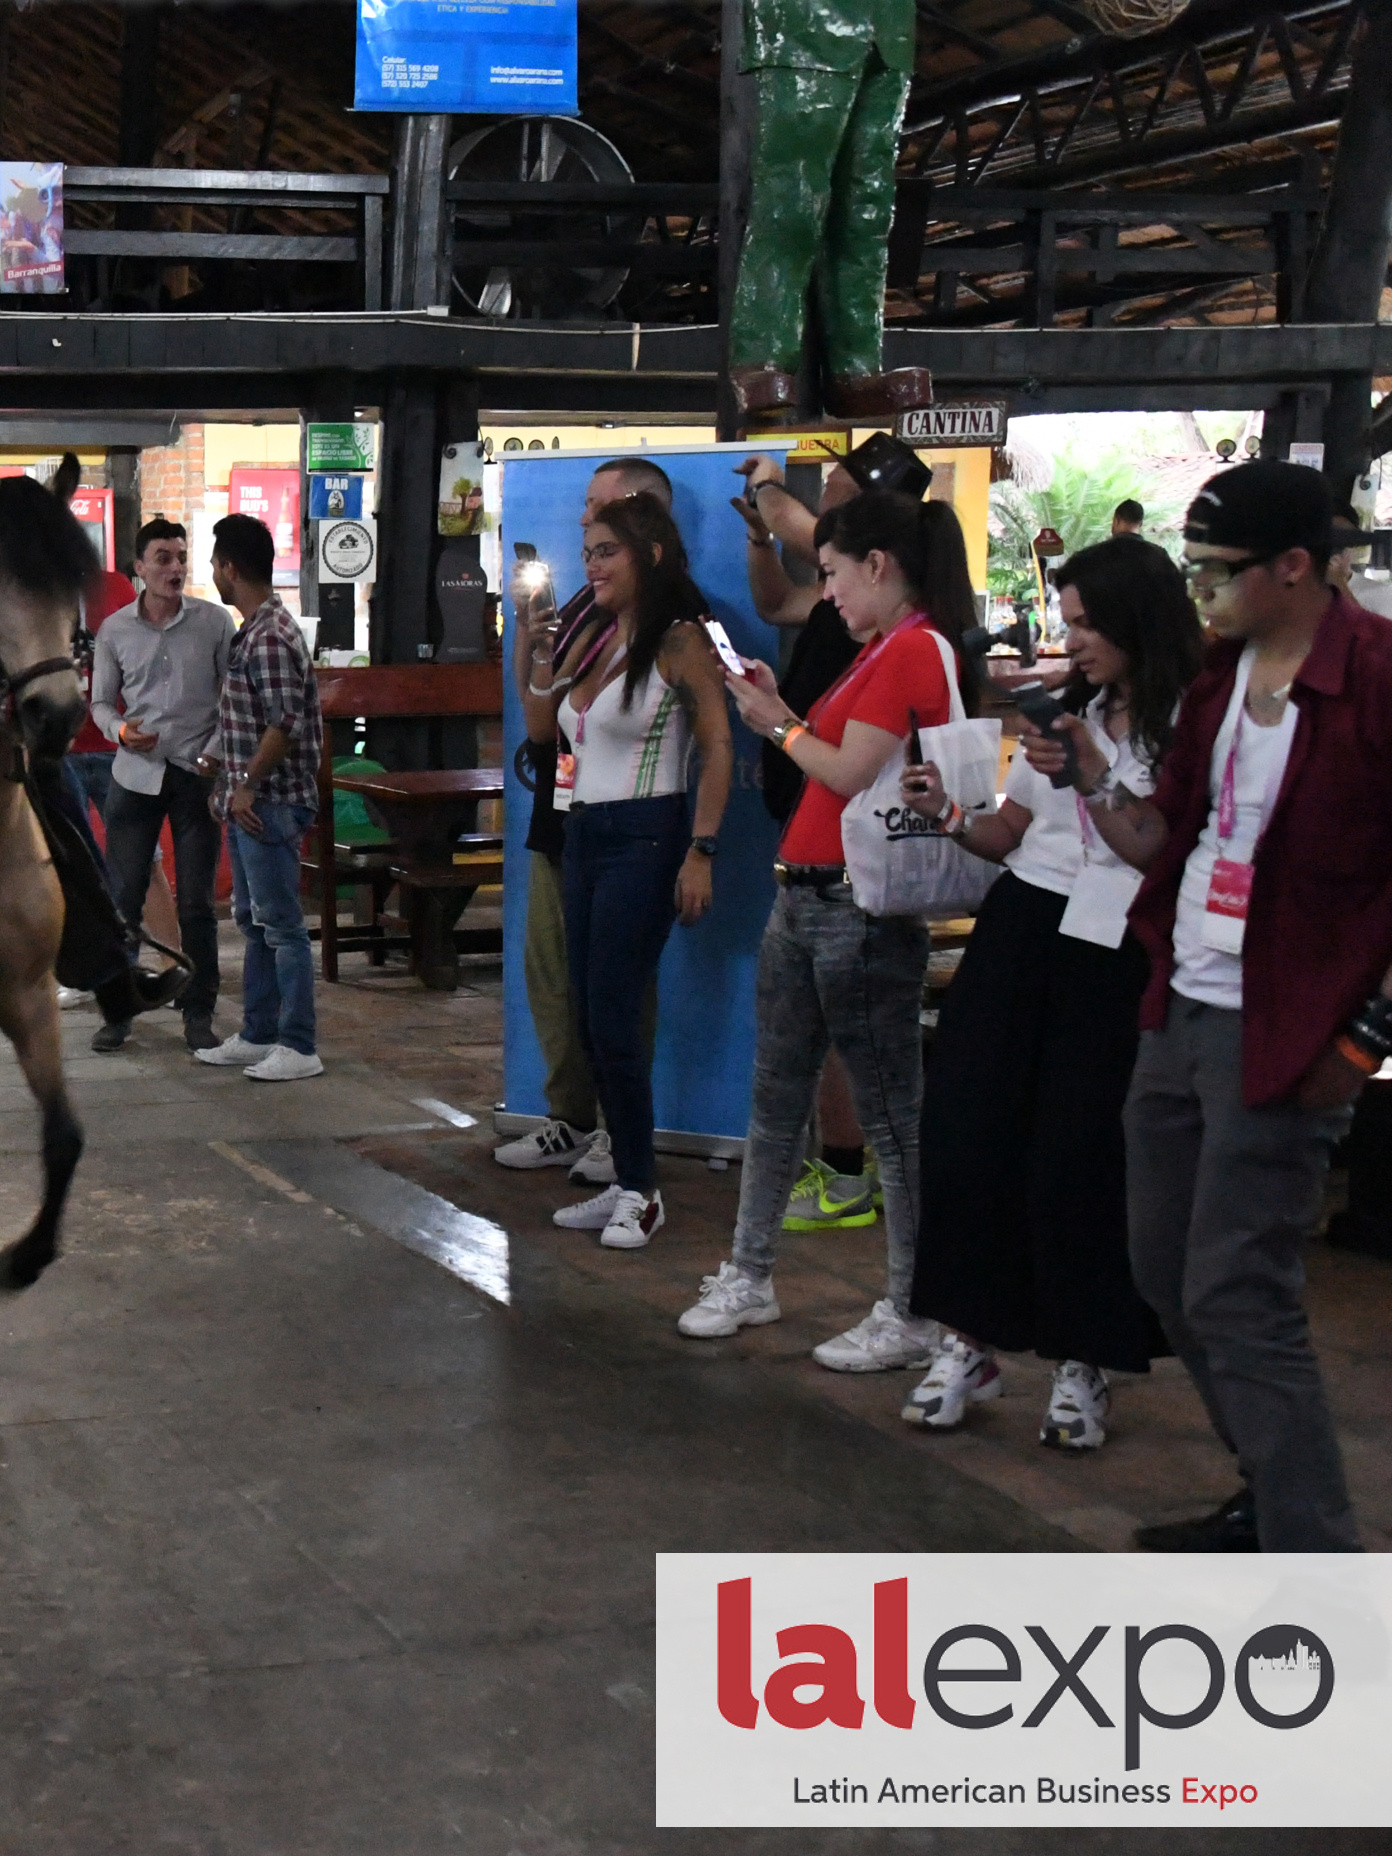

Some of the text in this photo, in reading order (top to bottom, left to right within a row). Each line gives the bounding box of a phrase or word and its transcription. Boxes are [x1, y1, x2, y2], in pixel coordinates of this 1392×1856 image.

[7, 264, 61, 279] Barranquilla
[907, 409, 994, 436] CANTINA
[797, 439, 840, 451] UERA
[325, 478, 349, 490] BAR
[240, 486, 262, 498] THIS
[240, 500, 269, 512] BUD'S
[328, 525, 368, 544] ESTABLECIMIENTO
[332, 562, 363, 574] AUTORIZADO
